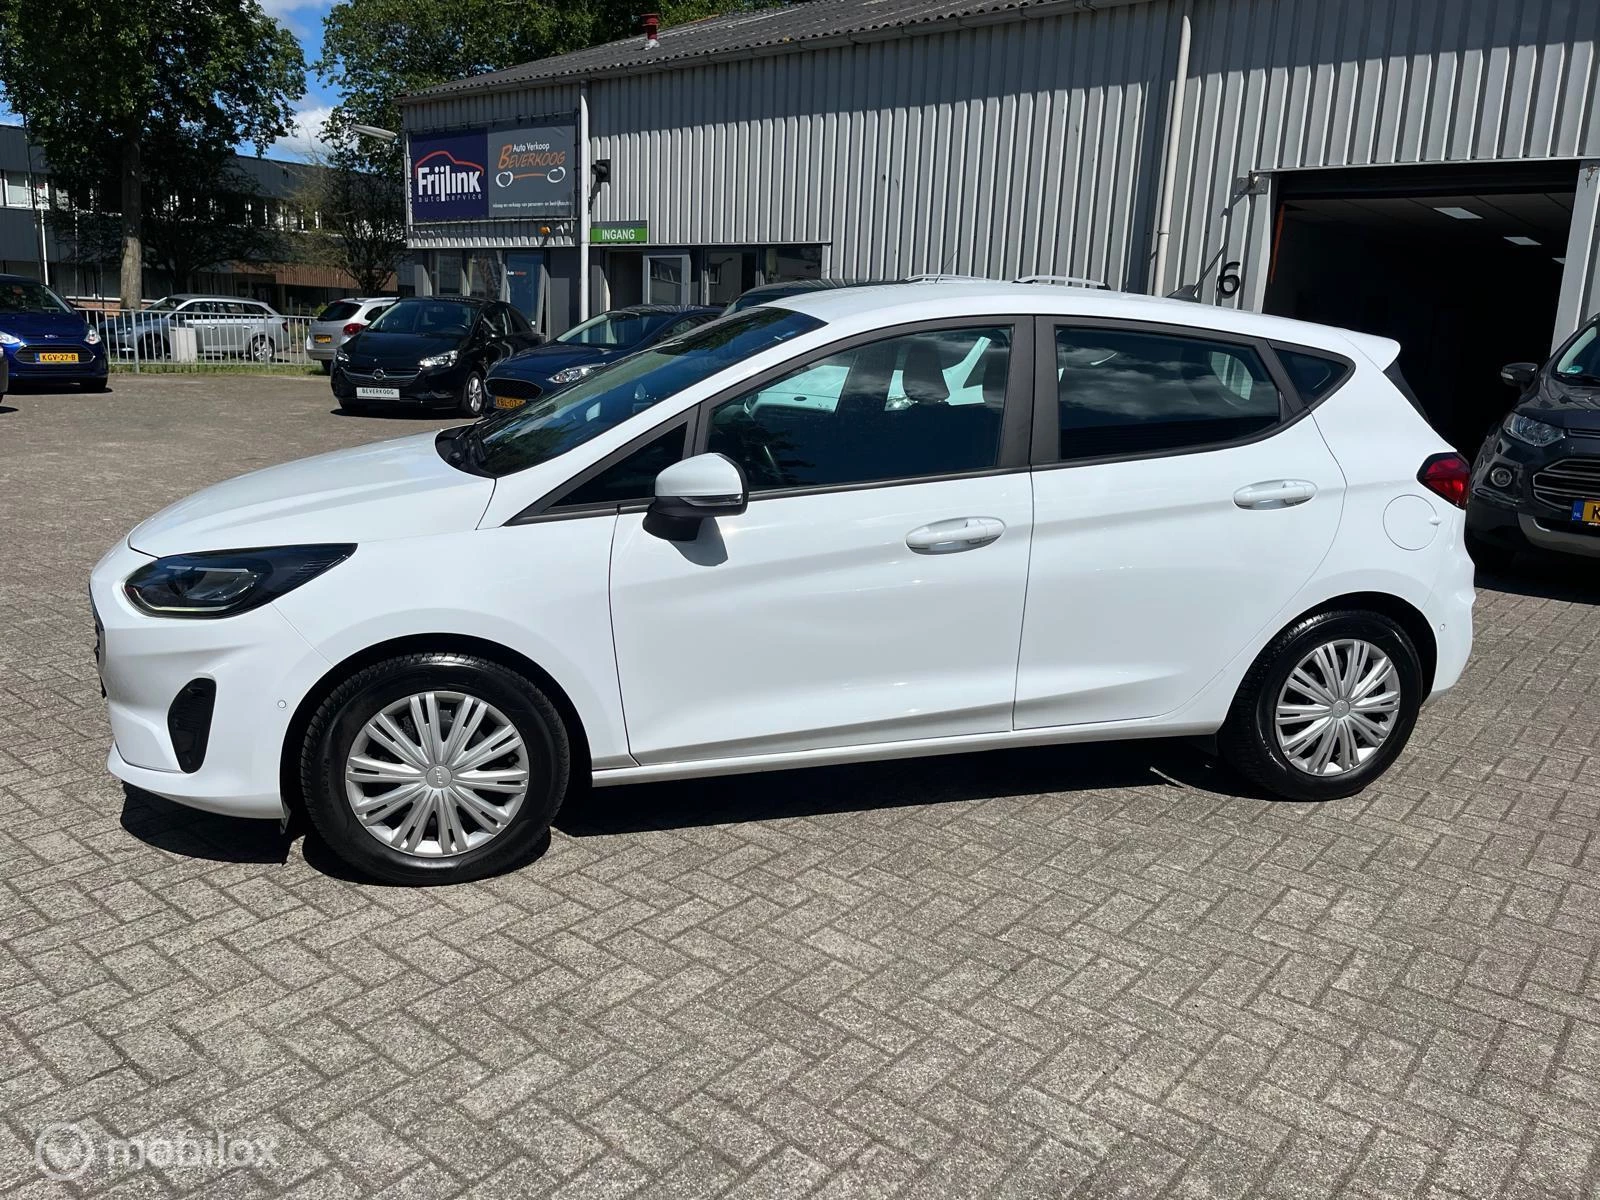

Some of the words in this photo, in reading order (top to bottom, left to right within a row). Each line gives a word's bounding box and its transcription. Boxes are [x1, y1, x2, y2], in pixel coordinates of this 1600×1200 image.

[513, 144, 526, 153] Auto
[526, 141, 550, 152] Verkoop
[601, 228, 636, 240] INGANG
[1219, 261, 1241, 299] 6
[41, 353, 77, 361] KGV-27-B
[361, 387, 395, 396] BEVERKOOG
